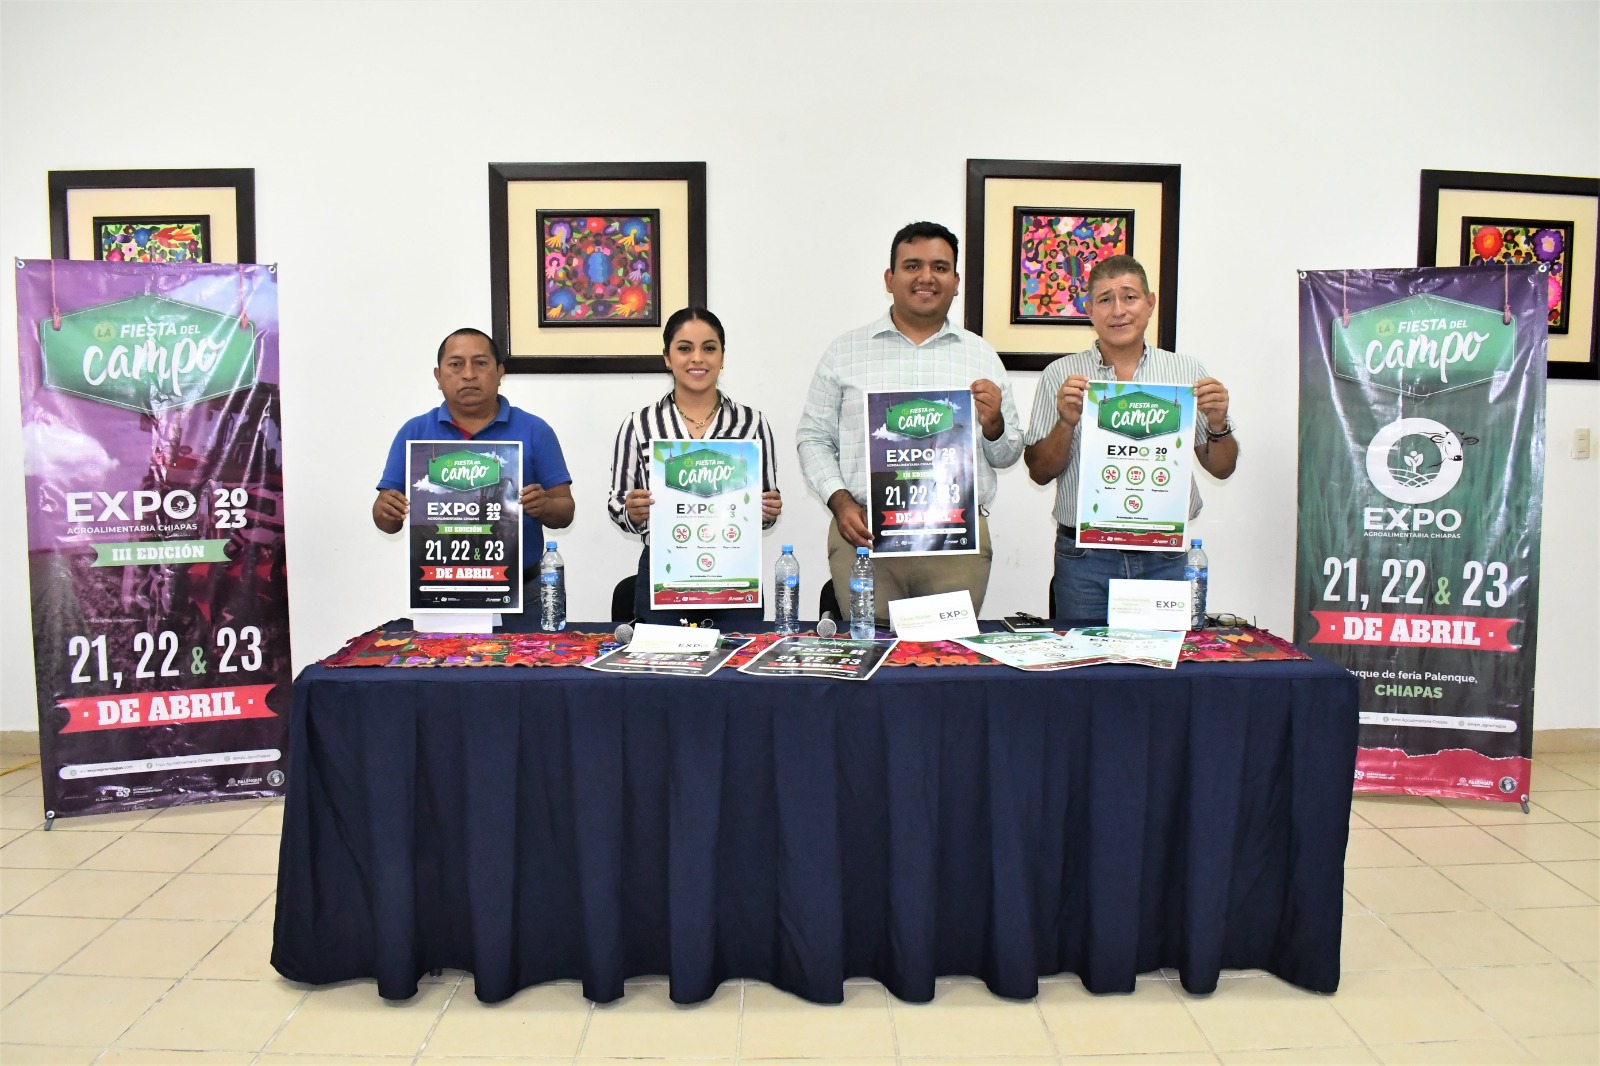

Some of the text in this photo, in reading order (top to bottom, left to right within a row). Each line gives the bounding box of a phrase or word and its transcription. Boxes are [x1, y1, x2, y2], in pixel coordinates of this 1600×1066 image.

[97, 322, 201, 338] LA FIESTA DEL
[1379, 318, 1468, 333] LA FIESTA DEL
[84, 337, 226, 396] campo
[1365, 331, 1490, 384] campo
[898, 412, 944, 433] campo
[1111, 408, 1170, 434] campo
[886, 448, 936, 462] EXPO
[1107, 444, 1150, 456] EXPO
[441, 465, 490, 487] campo
[678, 465, 736, 490] campo
[66, 490, 197, 522] EXPO
[214, 488, 248, 508] 20
[885, 485, 928, 508] 21, 22
[427, 502, 480, 516] EXPO
[486, 502, 502, 512] 20
[486, 511, 501, 520] 23
[214, 509, 248, 529] 23
[895, 512, 912, 523] DE
[1363, 507, 1462, 532] EXPO
[66, 523, 198, 535] AGROALIMENTARIA CHIAPAS
[1364, 531, 1428, 539] AGROALIMENTARIA
[112, 544, 204, 562] III EDICIÓN
[426, 540, 504, 564] 21, 22 & 23
[436, 568, 494, 579] DE ABRIL
[1323, 556, 1508, 611] 21, 22 & 23
[1156, 600, 1185, 608] EXPO
[940, 610, 968, 620] EXPO
[1343, 616, 1480, 646] DE ABRIL
[68, 626, 262, 688] 21, 22 & 23
[1346, 668, 1478, 685] arque de feria Palenque,
[1374, 684, 1443, 699] CHIAPAS
[97, 692, 241, 726] DE ABRIL
